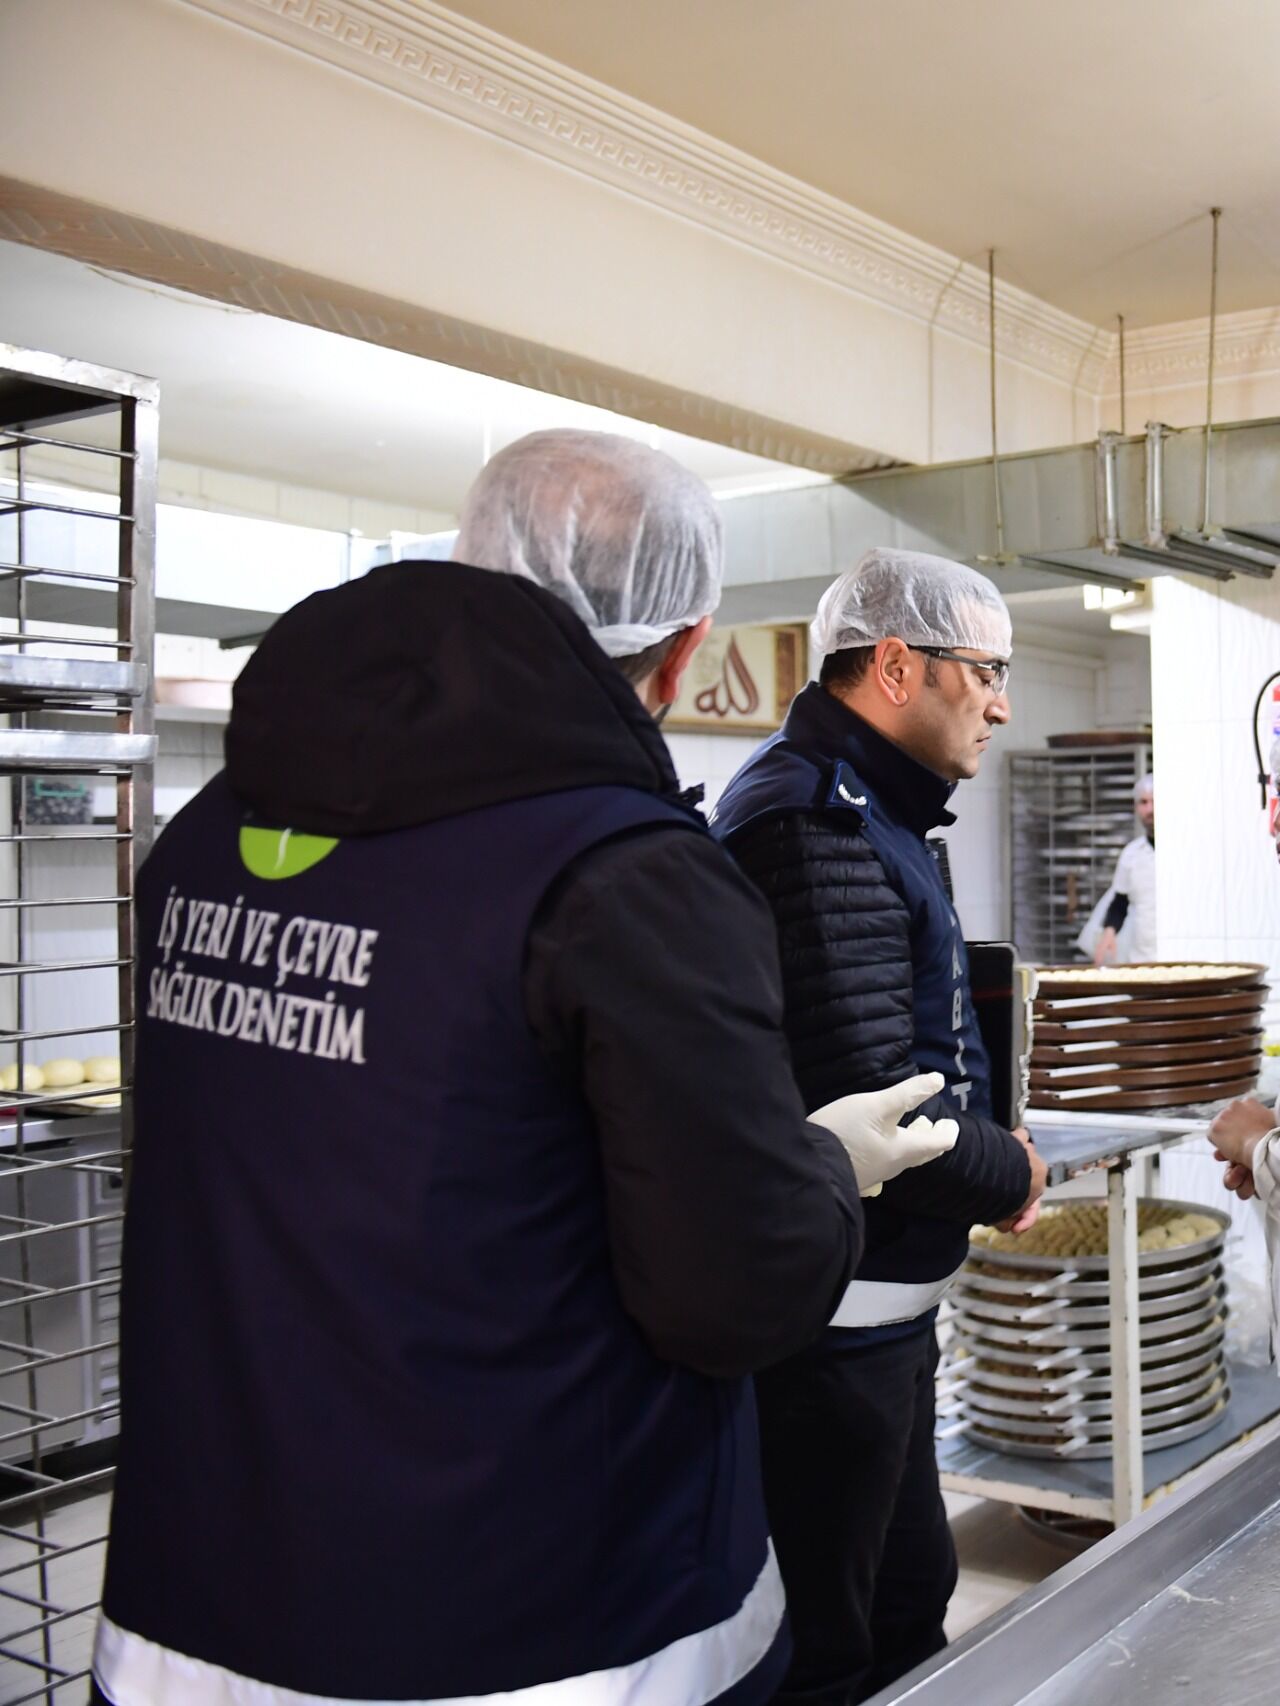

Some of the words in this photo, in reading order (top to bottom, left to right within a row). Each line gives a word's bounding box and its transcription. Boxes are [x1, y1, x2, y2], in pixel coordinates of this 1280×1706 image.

[157, 885, 184, 963] İŞ
[181, 895, 244, 960] YERİ
[239, 908, 280, 967] VE
[275, 916, 379, 987] ÇEVRE
[147, 961, 223, 1034] SAĞLIK
[216, 982, 366, 1064] DENETİM
